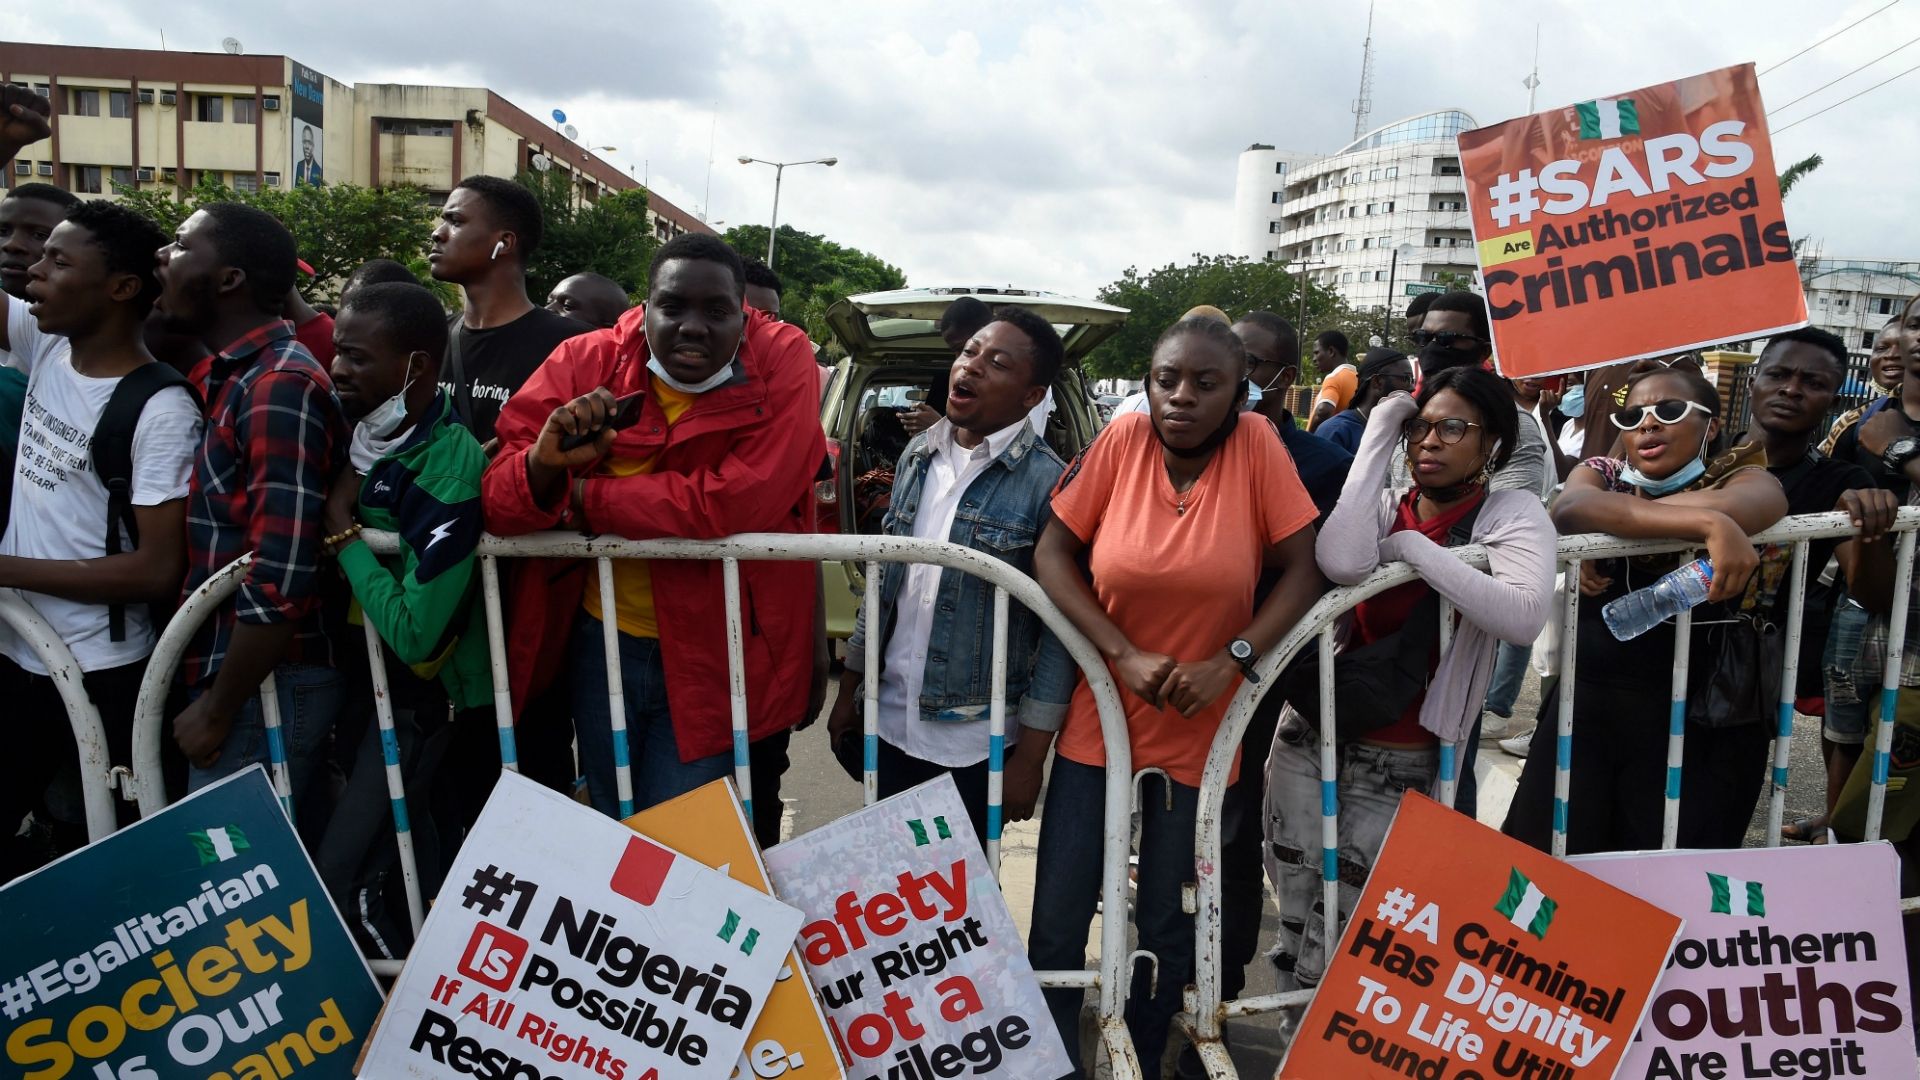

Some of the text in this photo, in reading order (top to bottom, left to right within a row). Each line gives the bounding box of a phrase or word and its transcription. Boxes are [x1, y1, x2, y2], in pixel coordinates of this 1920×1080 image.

[294, 77, 324, 105] New Dawn
[1489, 120, 1754, 229] #SARS
[1503, 176, 1759, 255] Are Authorized
[1483, 214, 1795, 321] Criminals
[43, 413, 78, 443] UNSIGNED
[65, 453, 88, 471] THEM
[1, 863, 280, 1021] #Egalitarian
[461, 864, 754, 1030] #1 Nigeria
[800, 858, 968, 966] afety
[1376, 886, 1626, 1024] #A Criminal
[1666, 926, 1877, 969] outhern
[6, 897, 313, 1080] Society
[469, 935, 708, 1067] Is Possible
[818, 916, 988, 1010] ur Right
[934, 975, 984, 1023] a
[1348, 918, 1612, 1068] Has Dignity
[1633, 966, 1902, 1042] ouths
[167, 982, 284, 1067] Our
[206, 998, 354, 1080] and
[430, 974, 628, 1080] If All Rights
[1322, 1010, 1449, 1080] Found
[1354, 975, 1402, 1025] To
[1406, 1002, 1484, 1062] Life
[1644, 1038, 1867, 1080] Are Legit
